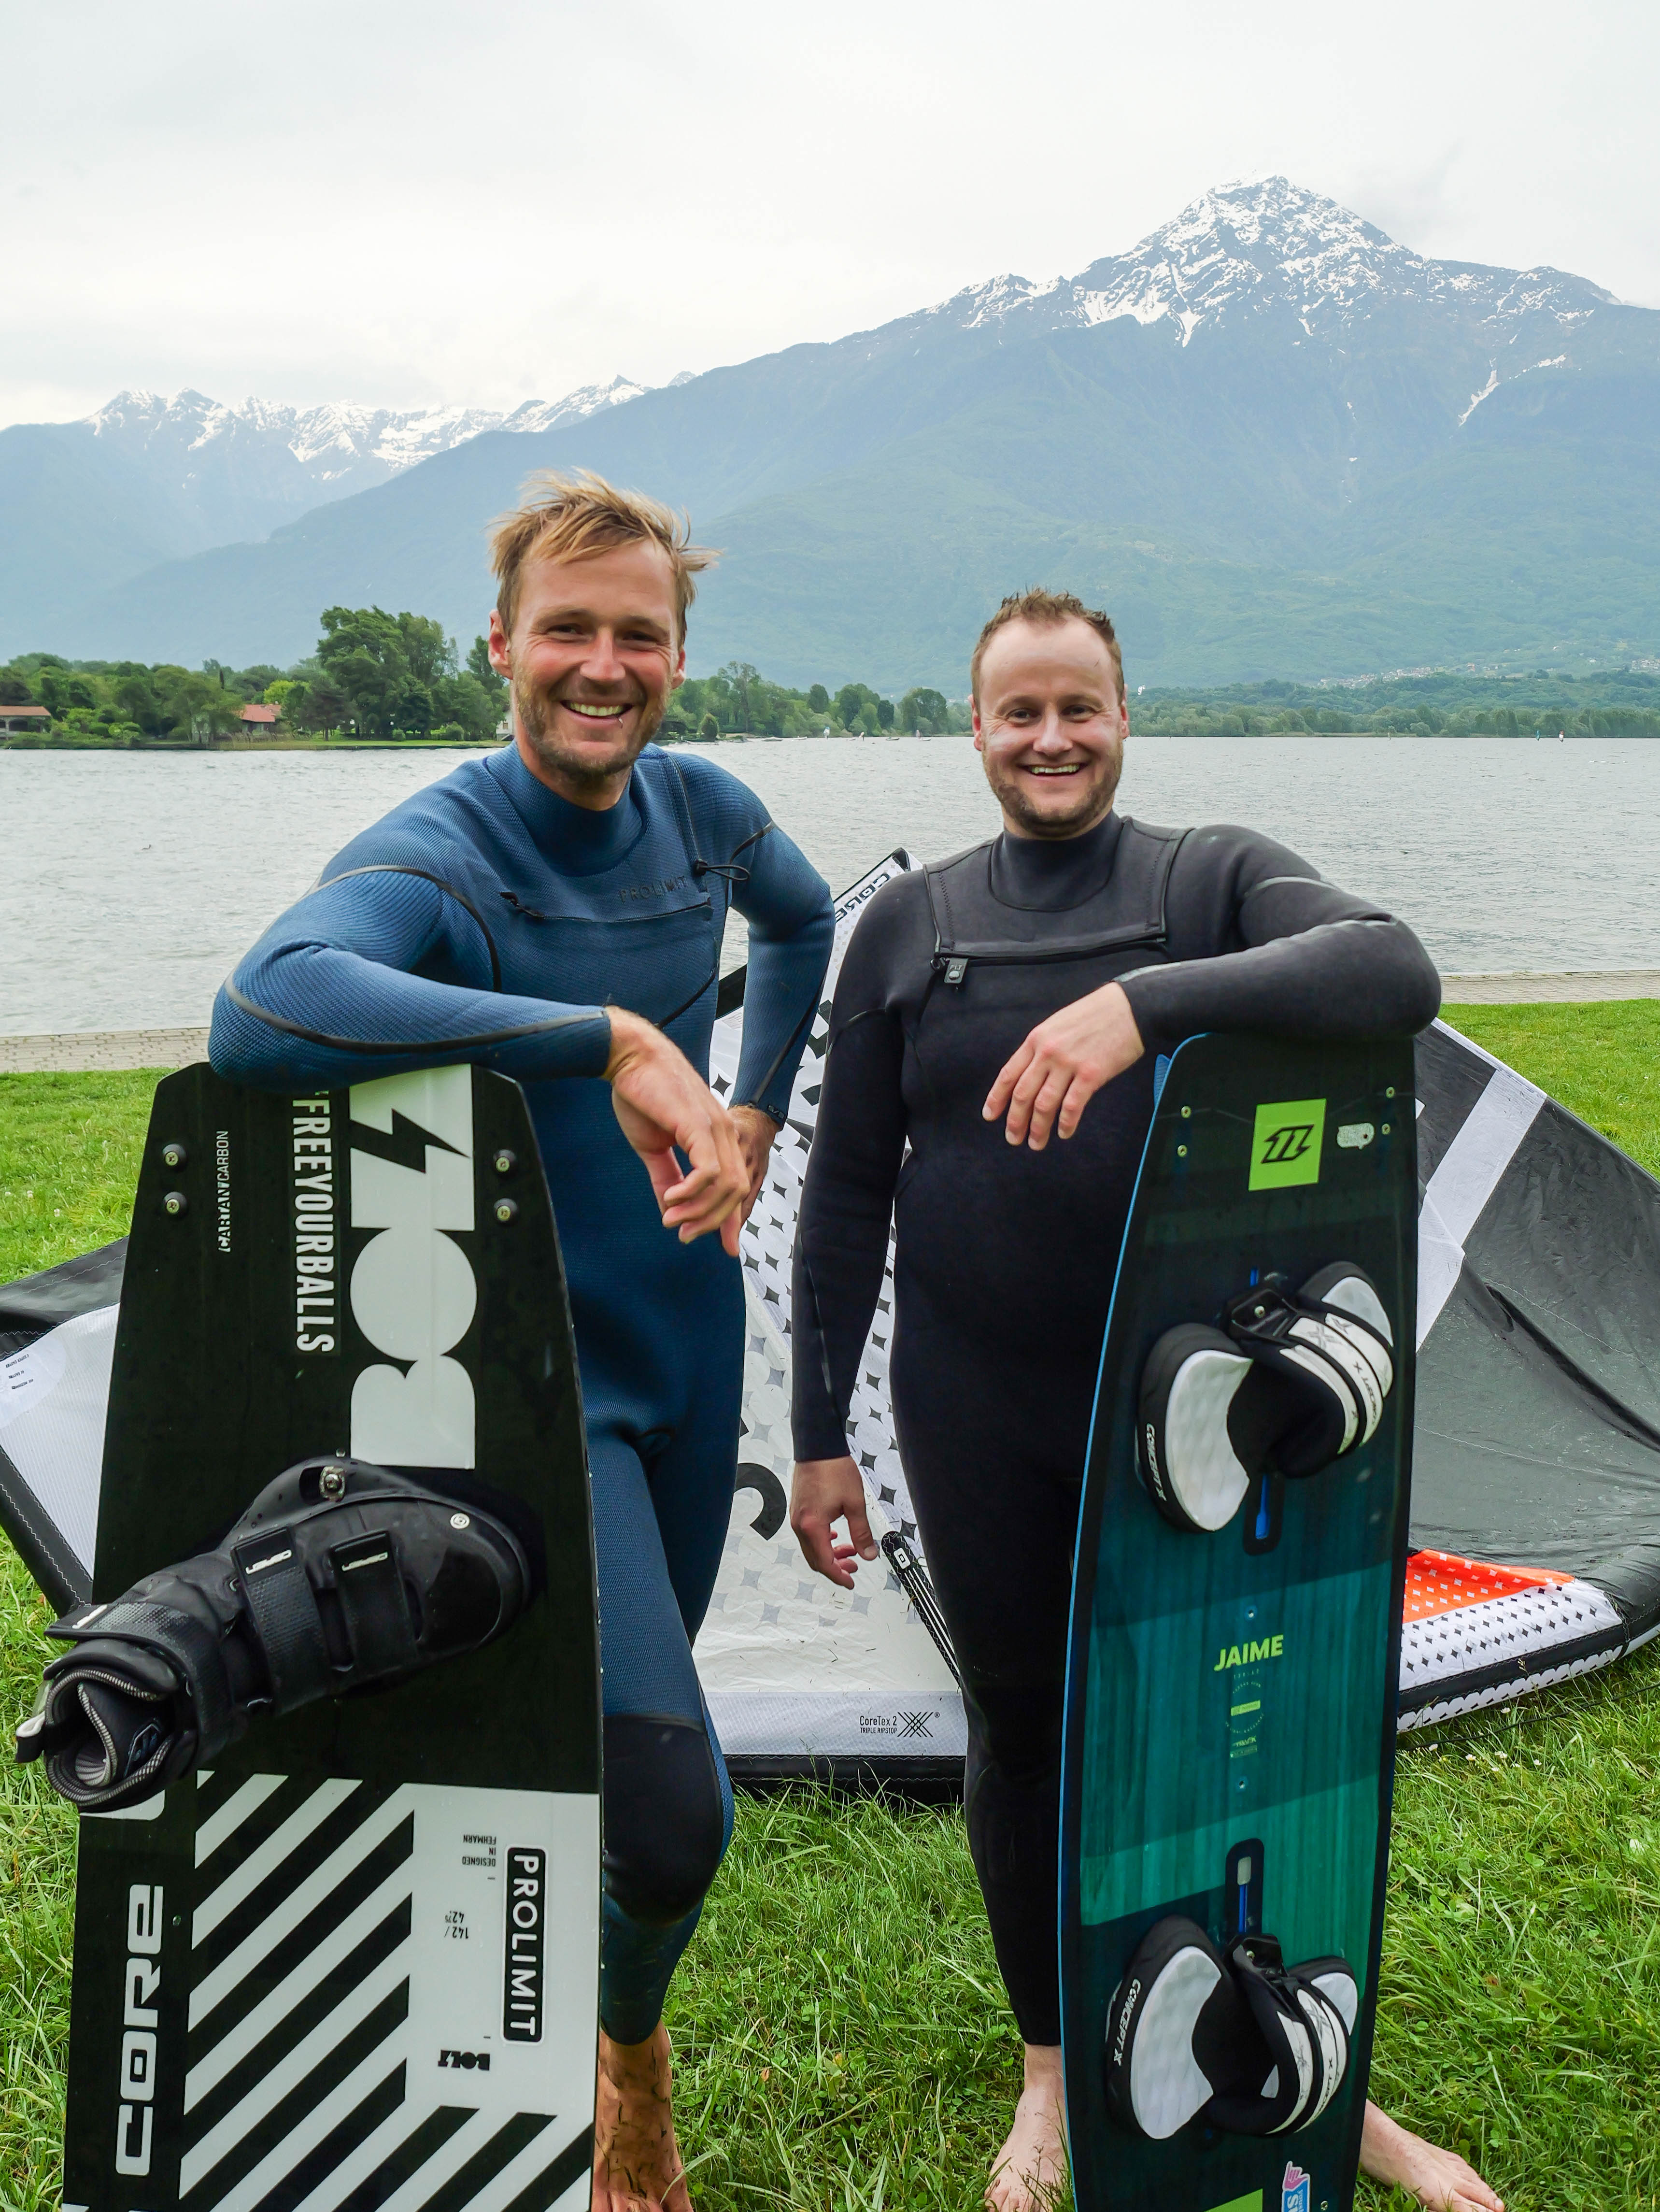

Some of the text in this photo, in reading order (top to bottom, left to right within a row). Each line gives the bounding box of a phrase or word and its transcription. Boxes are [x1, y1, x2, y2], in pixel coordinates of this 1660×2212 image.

[292, 1090, 335, 1352] FREEYOURBALLS
[1213, 1634, 1284, 1672] JAIME
[860, 1715, 897, 1726] CoreTex 2
[463, 1834, 497, 1845] FEHMARN
[489, 1847, 496, 1855] IN
[462, 1856, 496, 1867] DESIGNED
[510, 1855, 539, 2036] PROLIMIT
[115, 1884, 164, 2177] CORE
[1113, 1978, 1141, 2067] CONCEPT X
[438, 2049, 490, 2071] BOLT
